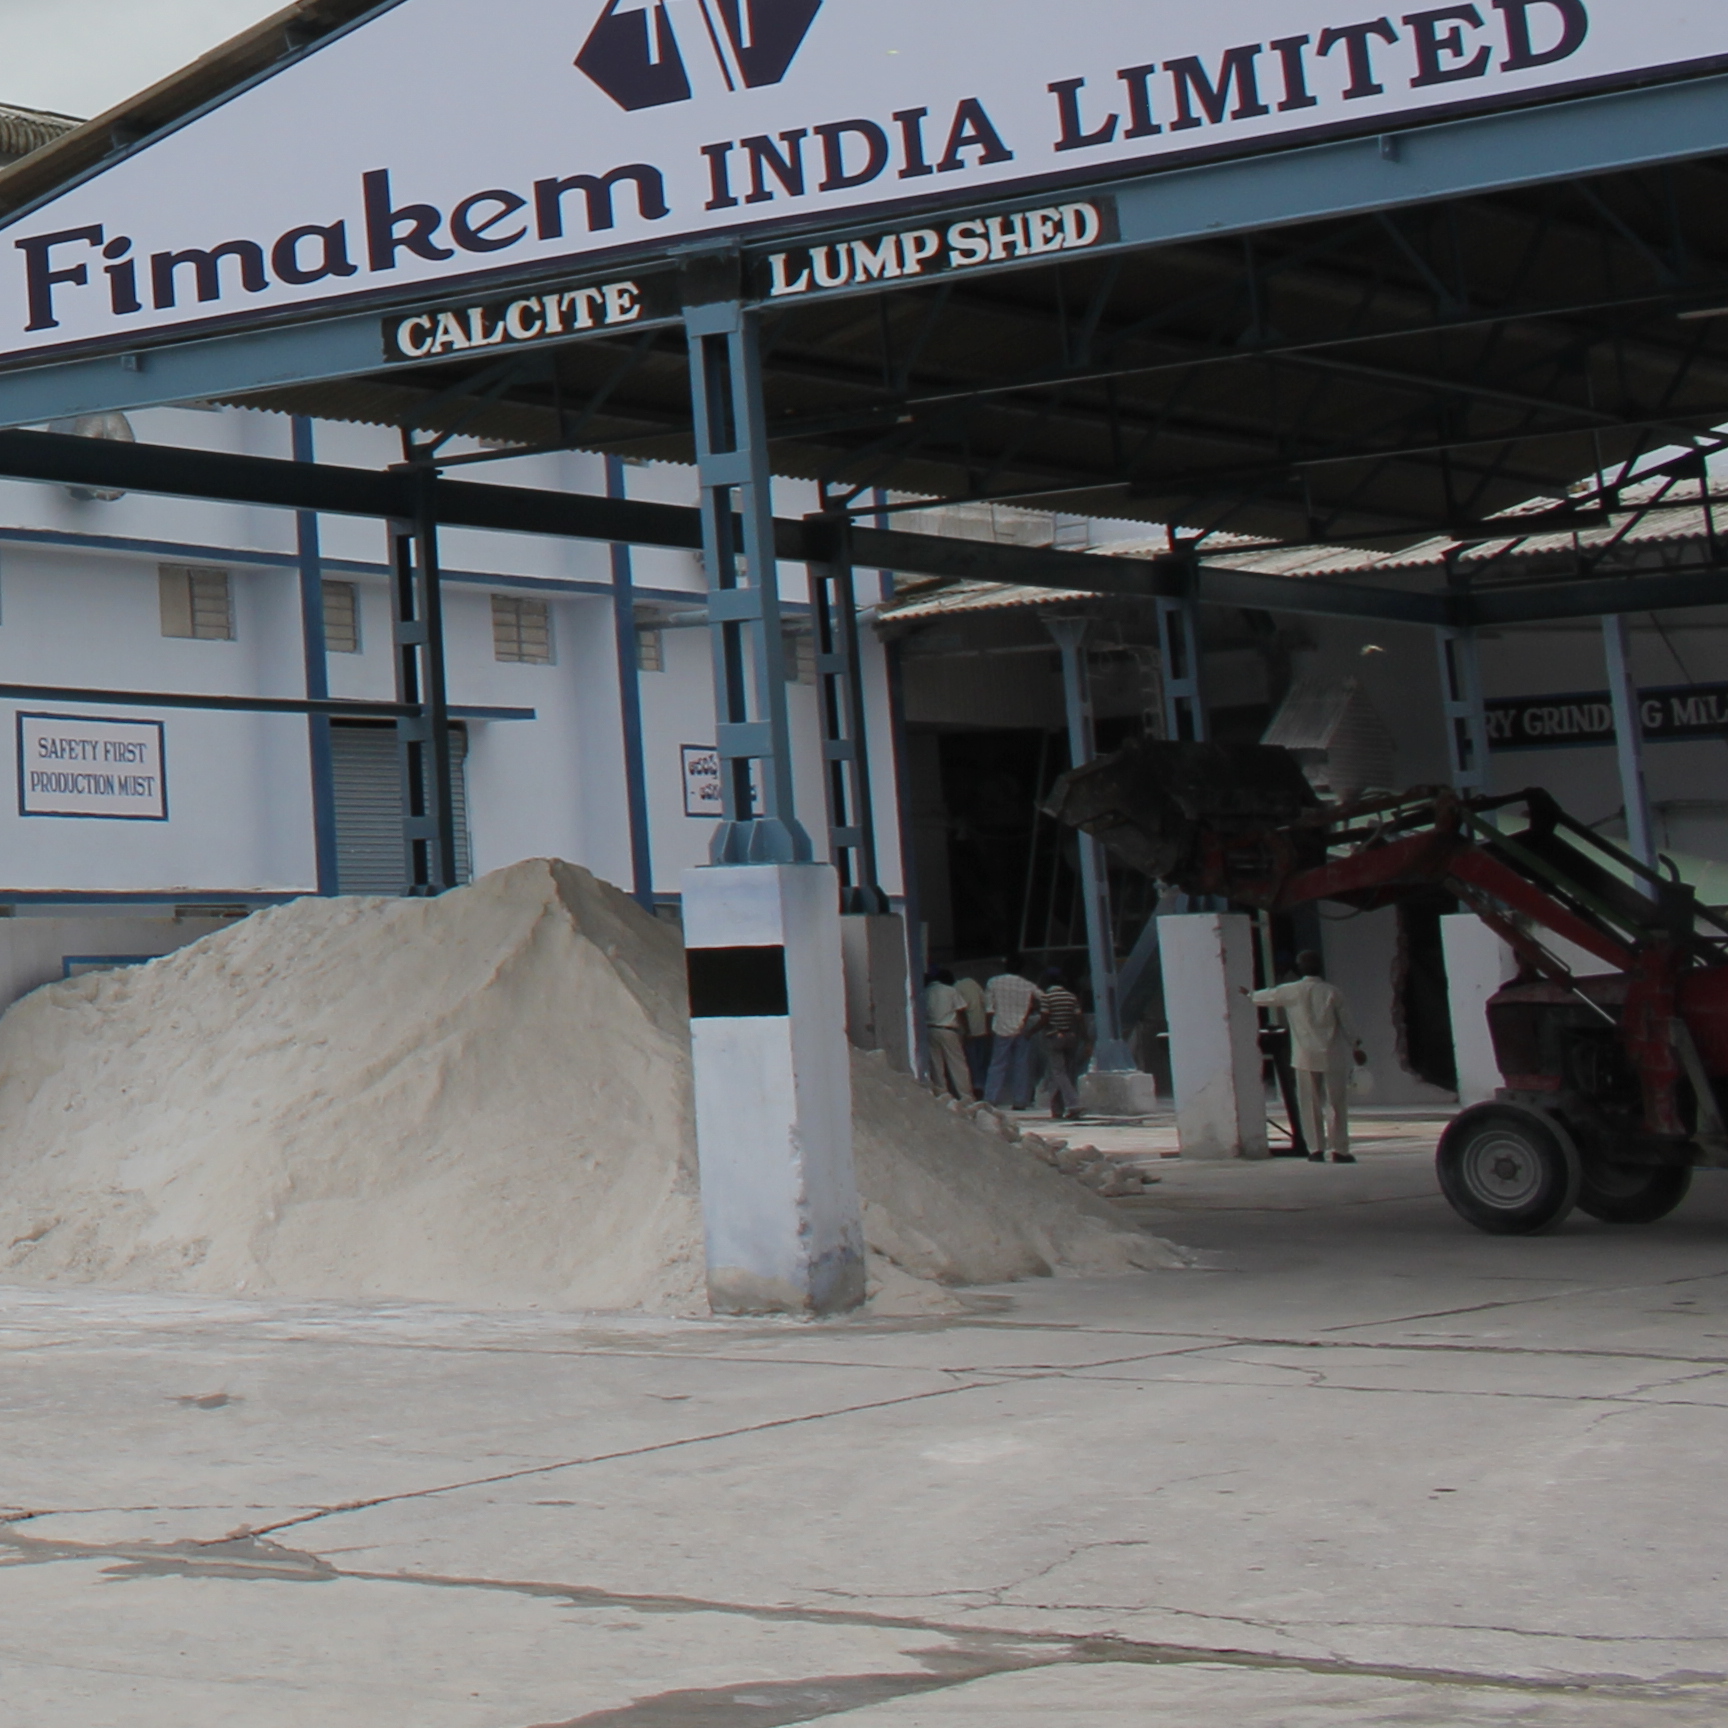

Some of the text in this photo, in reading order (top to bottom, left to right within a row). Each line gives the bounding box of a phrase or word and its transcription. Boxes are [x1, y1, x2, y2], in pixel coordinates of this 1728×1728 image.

[15, 162, 671, 332] Fimakem
[702, 97, 1012, 211] INDIA
[769, 202, 1100, 296] LUMP SHED
[396, 280, 641, 359] CALCITE
[1523, 699, 1663, 736] GRINDG
[1669, 693, 1728, 727] MIL
[38, 737, 147, 763] SAFETY FIRST
[30, 771, 155, 797] PRODUCTION MUST
